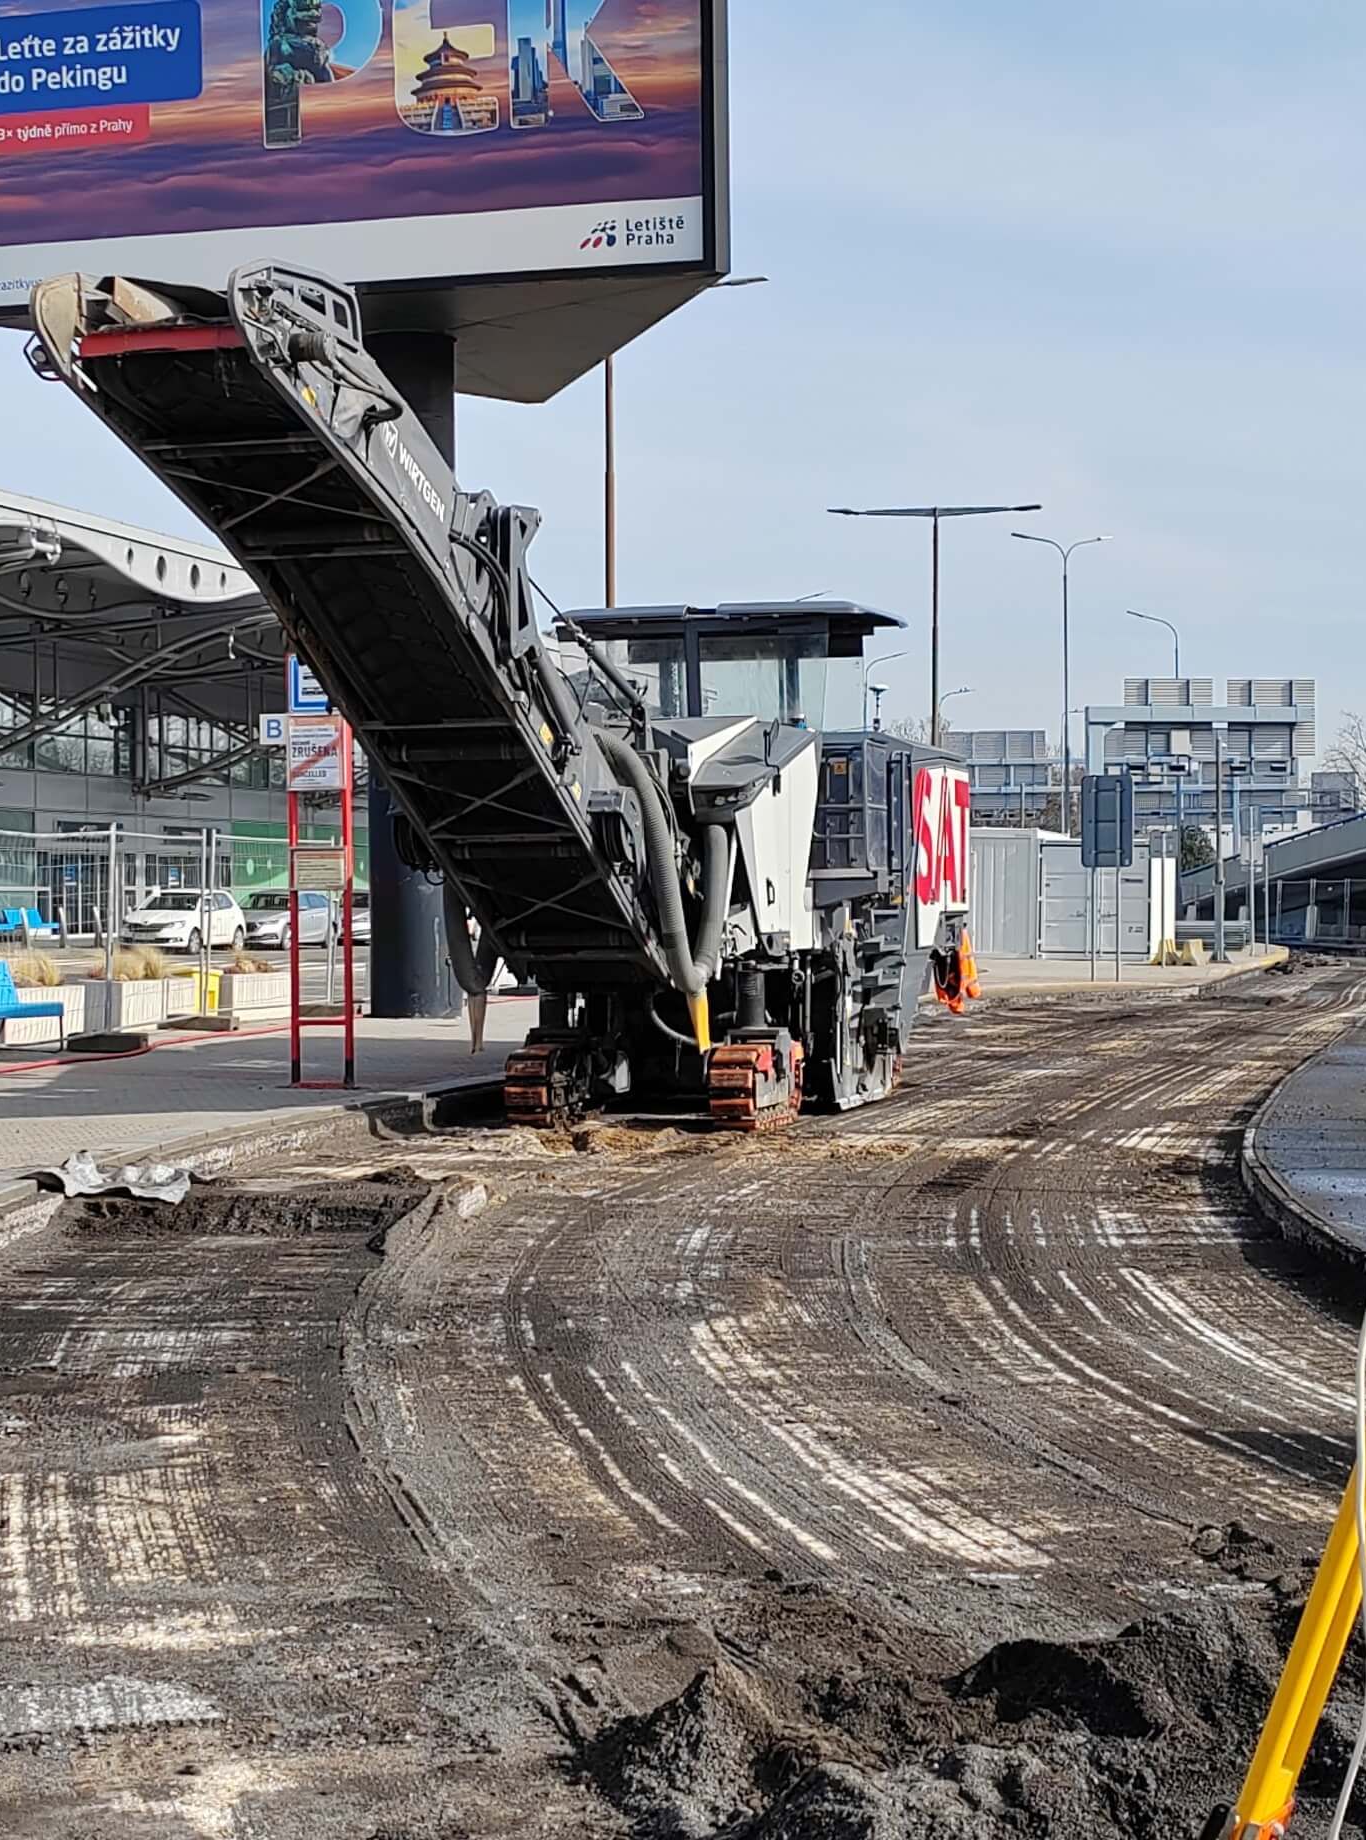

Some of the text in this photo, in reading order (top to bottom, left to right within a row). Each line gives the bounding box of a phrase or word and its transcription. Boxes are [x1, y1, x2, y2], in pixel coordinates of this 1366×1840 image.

[63, 34, 89, 54] za
[95, 24, 181, 51] zážitky
[31, 64, 128, 91] Pekingu
[16, 123, 52, 142] týdně
[54, 122, 88, 138] přímo
[90, 123, 97, 134] z
[99, 119, 134, 134] Prahy
[626, 215, 685, 232] Letiště
[626, 231, 675, 246] Praha
[399, 442, 445, 523] WIRTGEN
[266, 719, 283, 739] B
[914, 767, 970, 905] SAT
